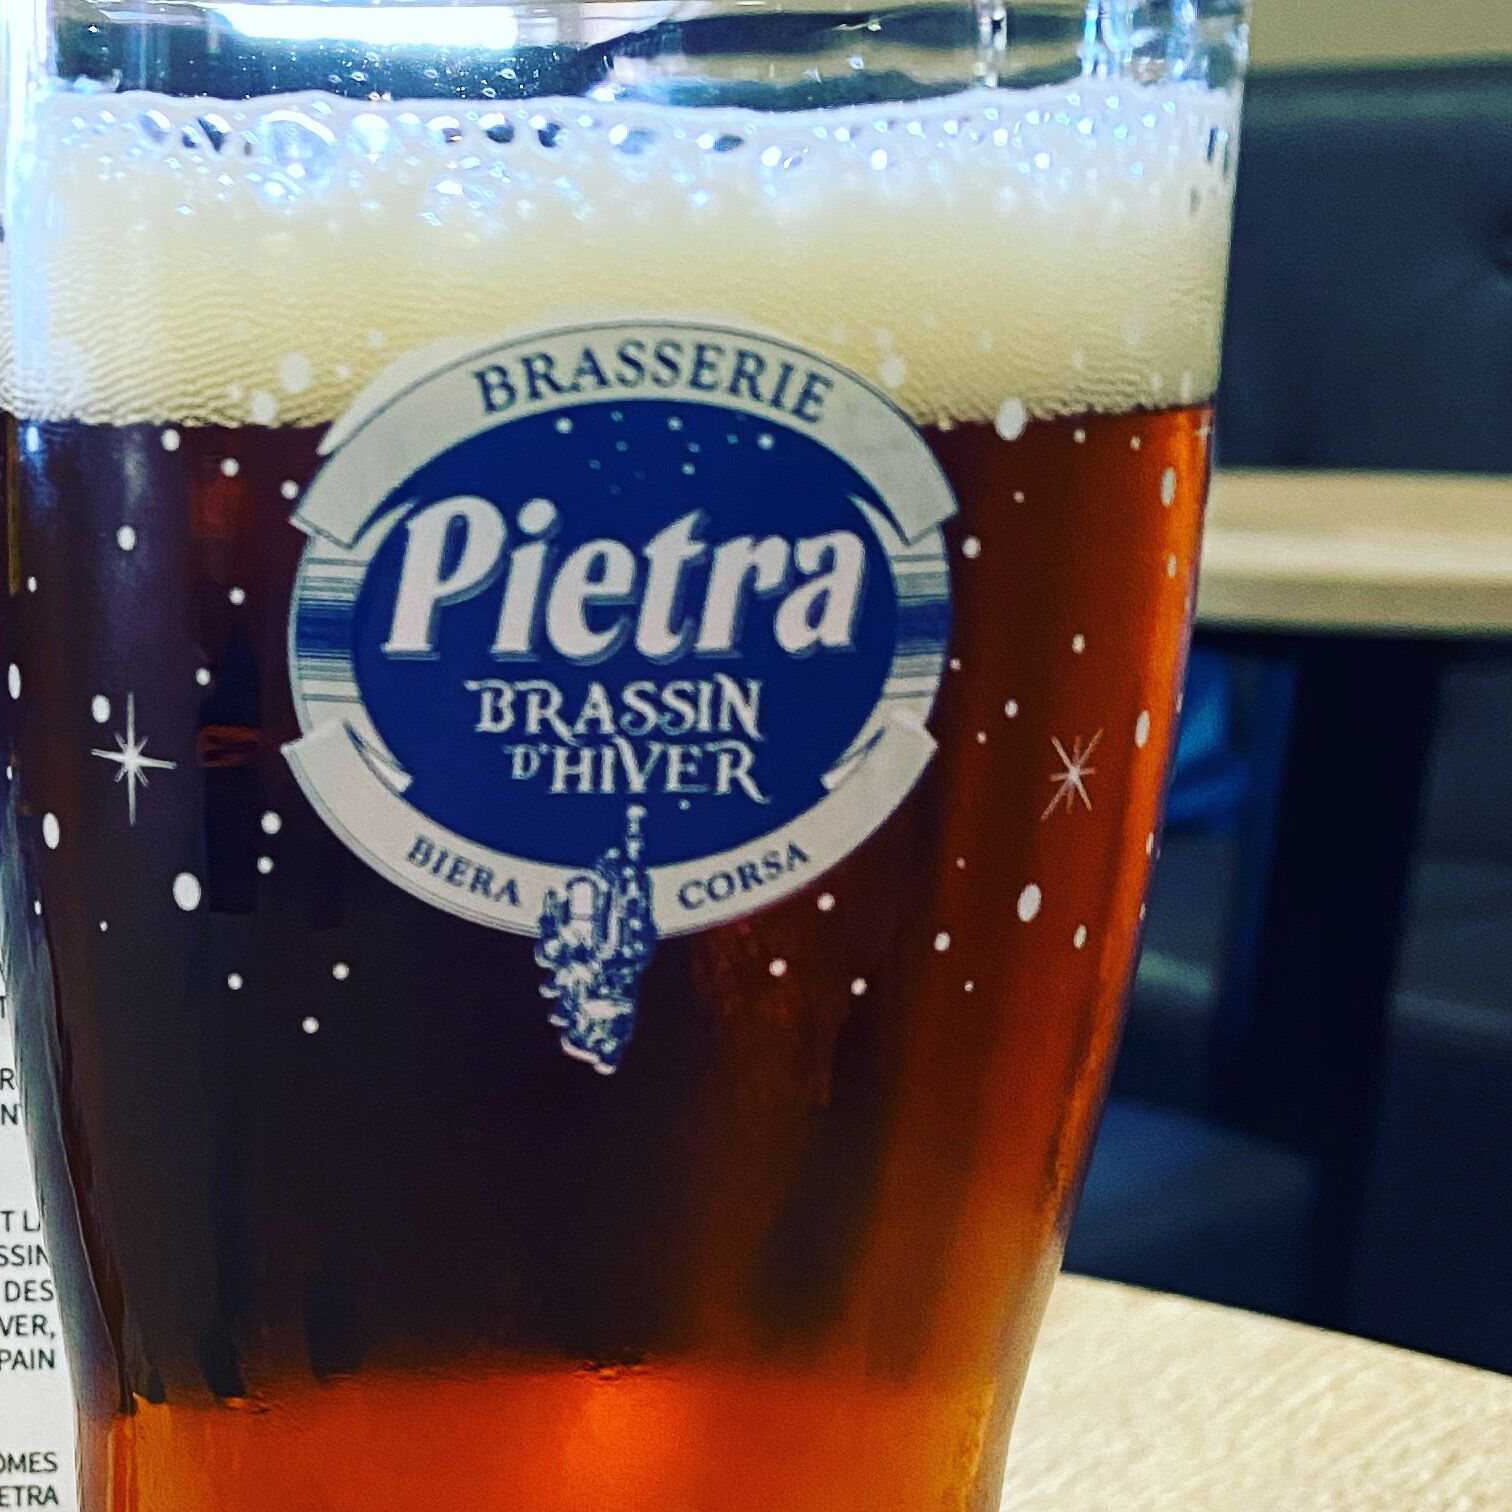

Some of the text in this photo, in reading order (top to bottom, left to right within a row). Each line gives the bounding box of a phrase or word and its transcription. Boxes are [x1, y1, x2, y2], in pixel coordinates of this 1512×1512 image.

[472, 339, 834, 424] BRASSERIE
[381, 495, 867, 664] Pietra
[464, 674, 766, 745] BRASSIN
[503, 736, 771, 803] D'HIVER
[406, 834, 812, 911] BIERA CORSA
[4, 1279, 54, 1303] DES
